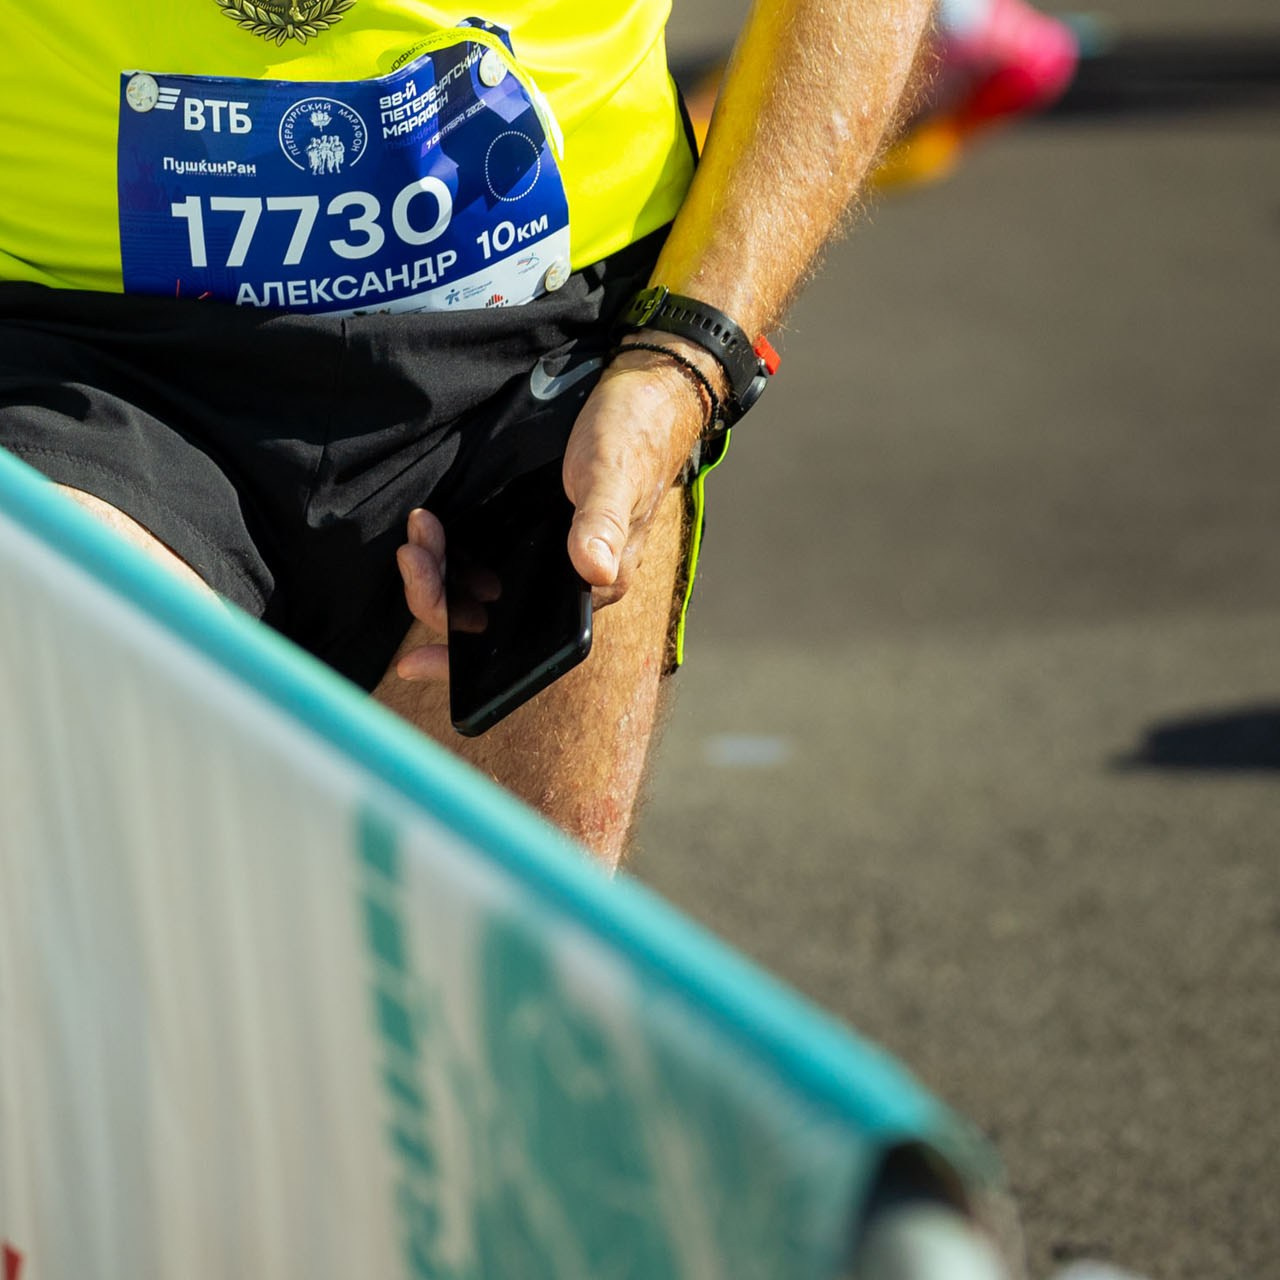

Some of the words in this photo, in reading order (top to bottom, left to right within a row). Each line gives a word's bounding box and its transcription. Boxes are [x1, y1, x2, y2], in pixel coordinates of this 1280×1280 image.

[379, 80, 417, 109] 98-Й
[381, 43, 484, 124] ПЕТЕРБУРГСКИЙ
[184, 98, 252, 134] ВТБ
[284, 102, 331, 156] ПЕТЕРБУРГСКИЙ
[338, 109, 363, 152] МАРАФОН
[383, 91, 448, 139] МАРАФОН
[171, 176, 453, 268] 17730
[236, 249, 457, 308] АЛЕКСАНДР
